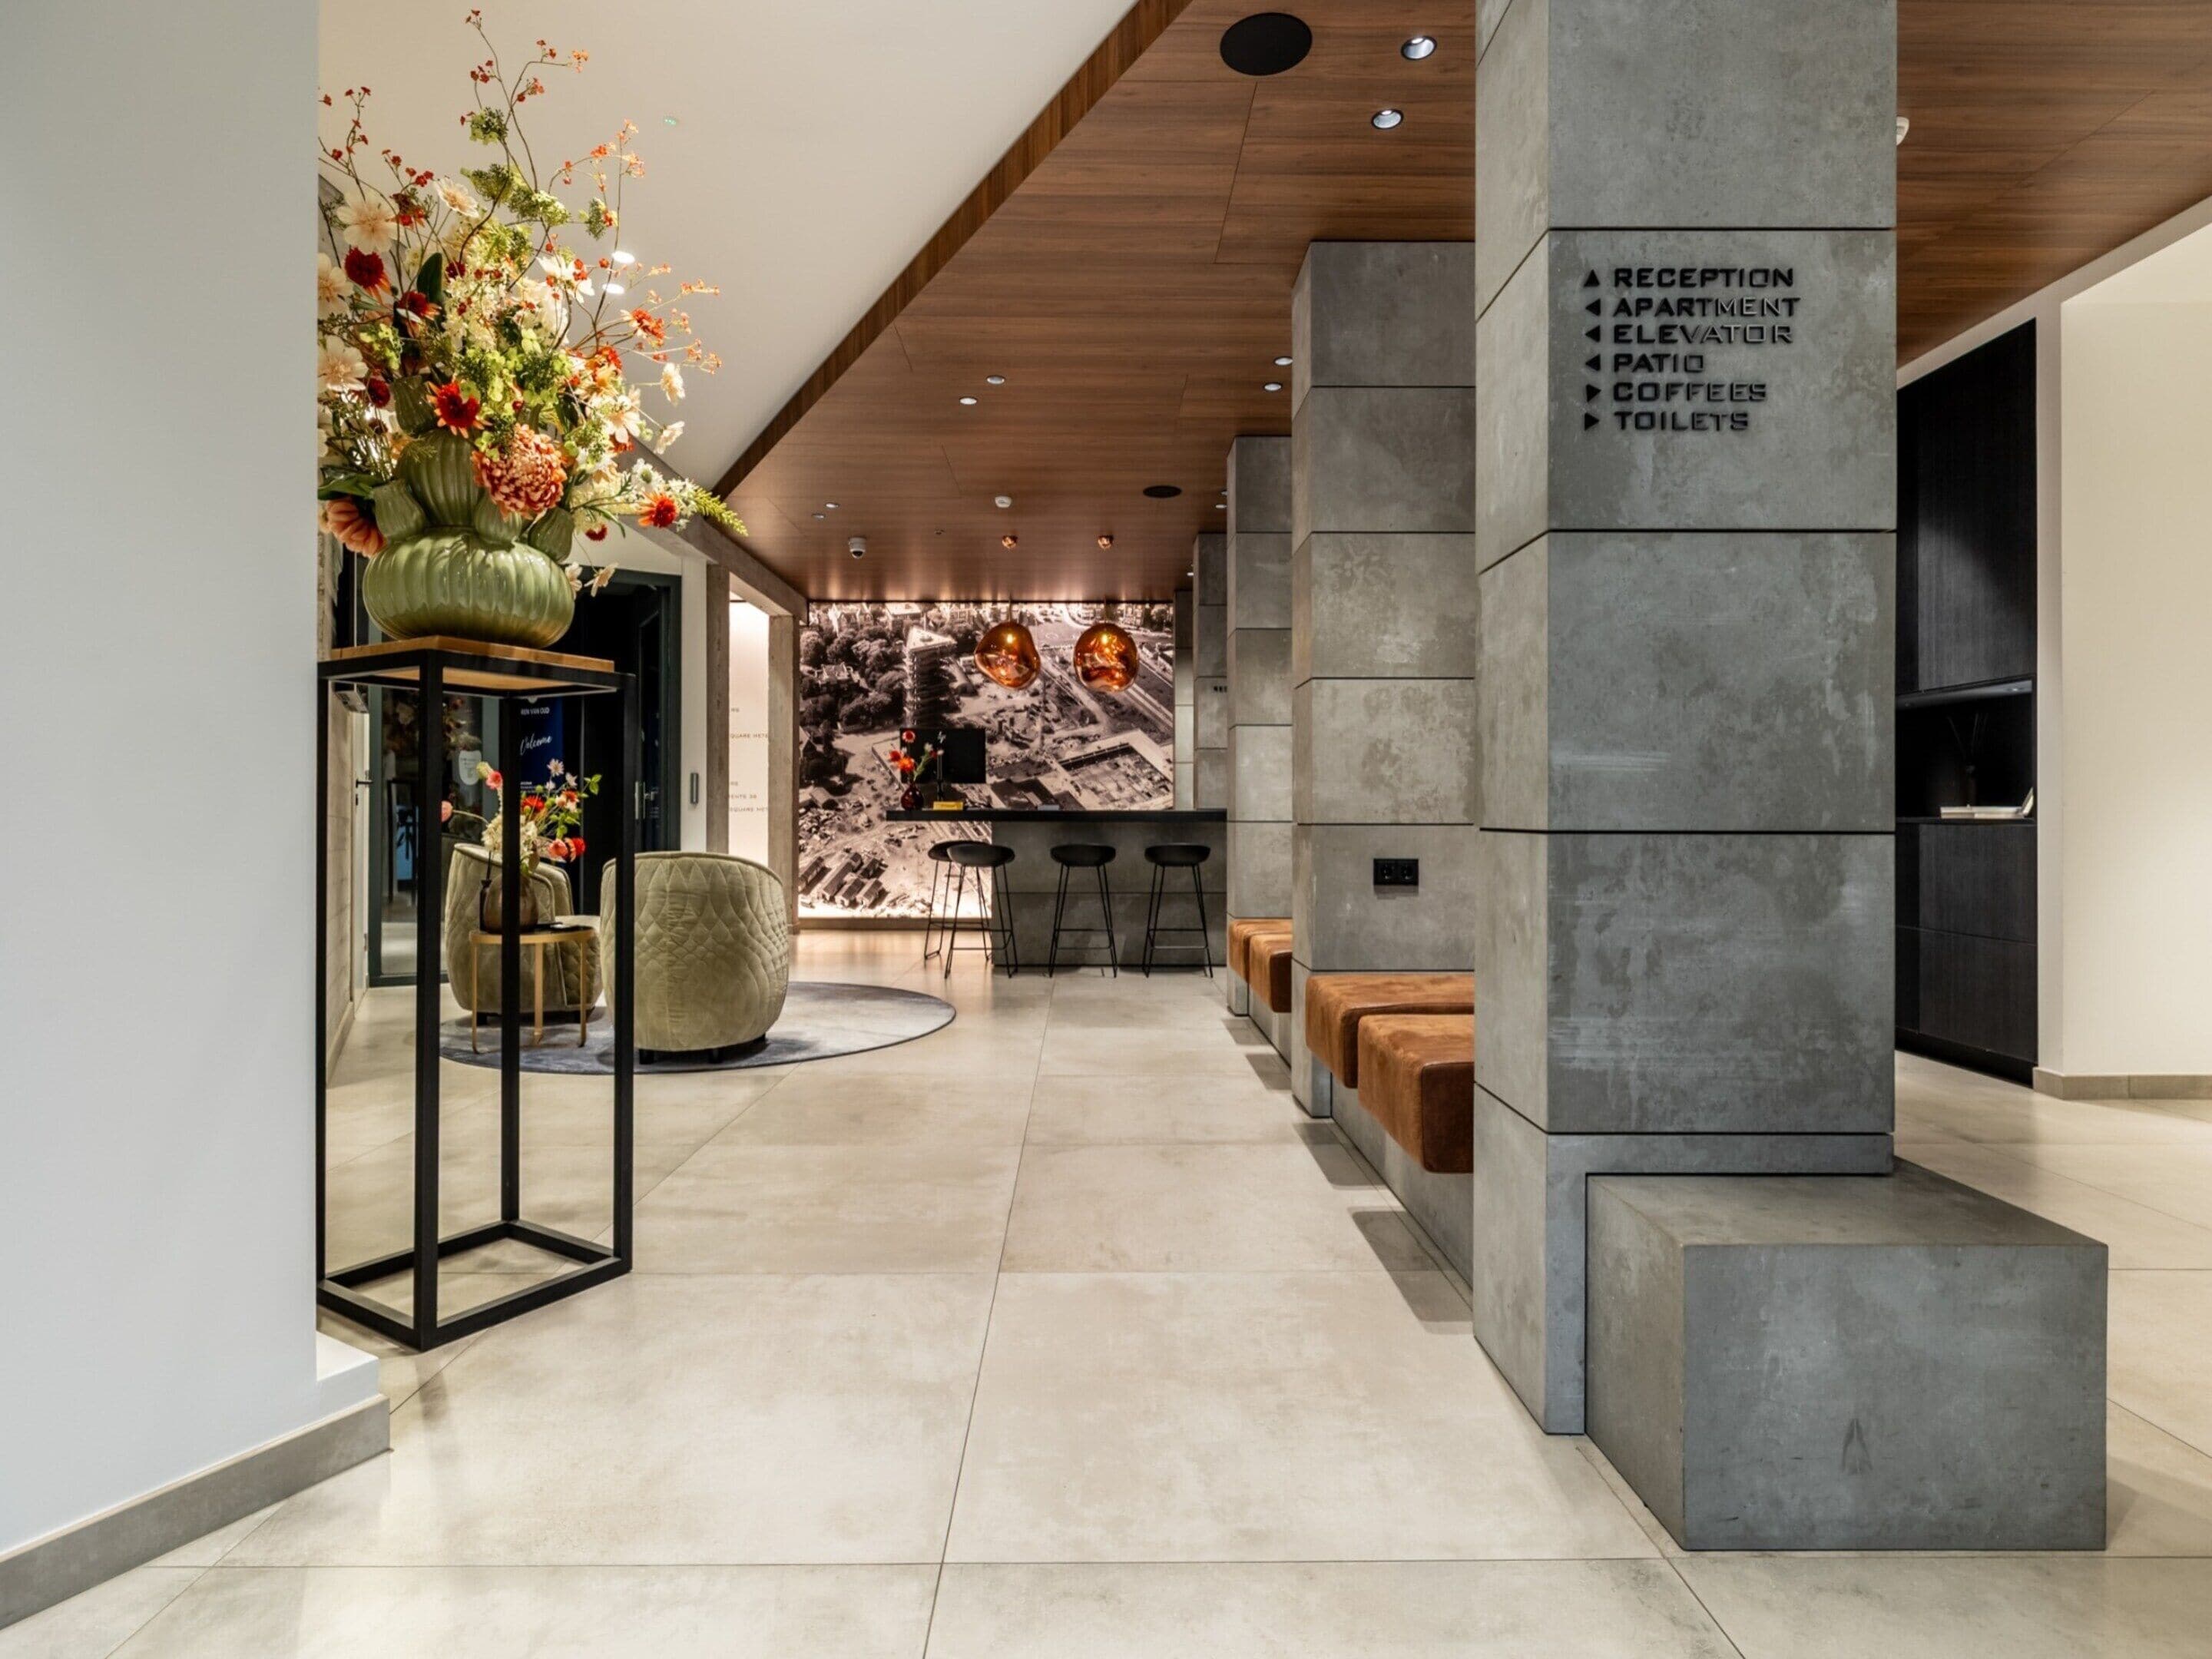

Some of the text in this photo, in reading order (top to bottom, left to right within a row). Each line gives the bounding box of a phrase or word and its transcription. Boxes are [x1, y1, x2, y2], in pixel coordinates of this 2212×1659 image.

[1614, 268, 1794, 288] RECEPTION
[1613, 297, 1801, 317] APARTMENT
[1613, 324, 1793, 344] ELEVATOR
[1614, 353, 1704, 373] PATIO
[1613, 382, 1767, 402] COFFEES
[1614, 411, 1750, 432] TOILETS
